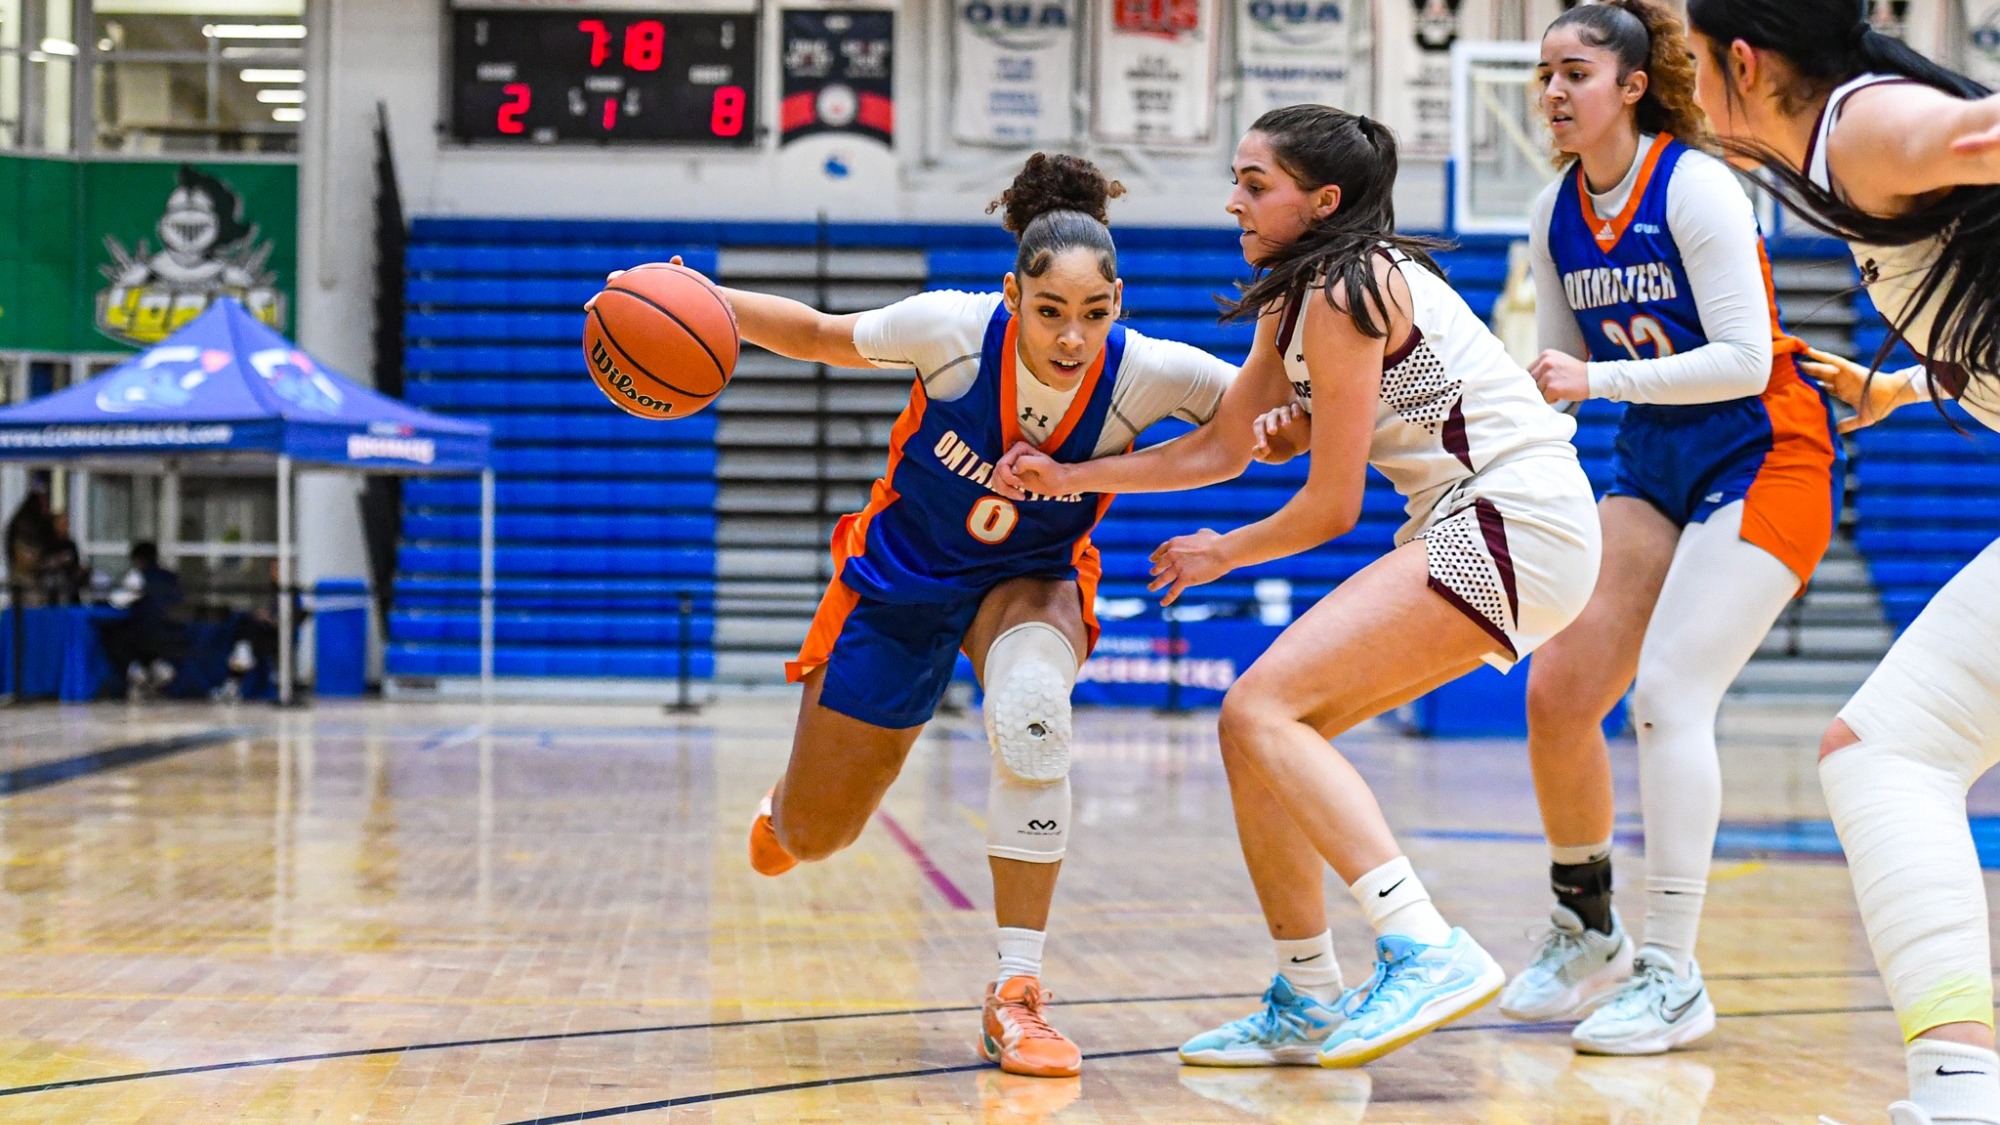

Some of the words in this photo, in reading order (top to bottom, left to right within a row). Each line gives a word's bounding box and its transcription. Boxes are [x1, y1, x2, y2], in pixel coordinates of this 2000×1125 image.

[965, 2, 1068, 29] OUA
[1248, 0, 1342, 24] OUA
[498, 83, 531, 133] 2
[603, 97, 618, 130] 1
[711, 85, 746, 136] 8
[1625, 261, 1677, 303] TECH
[591, 338, 672, 413] Wilson
[966, 495, 1019, 545] 0
